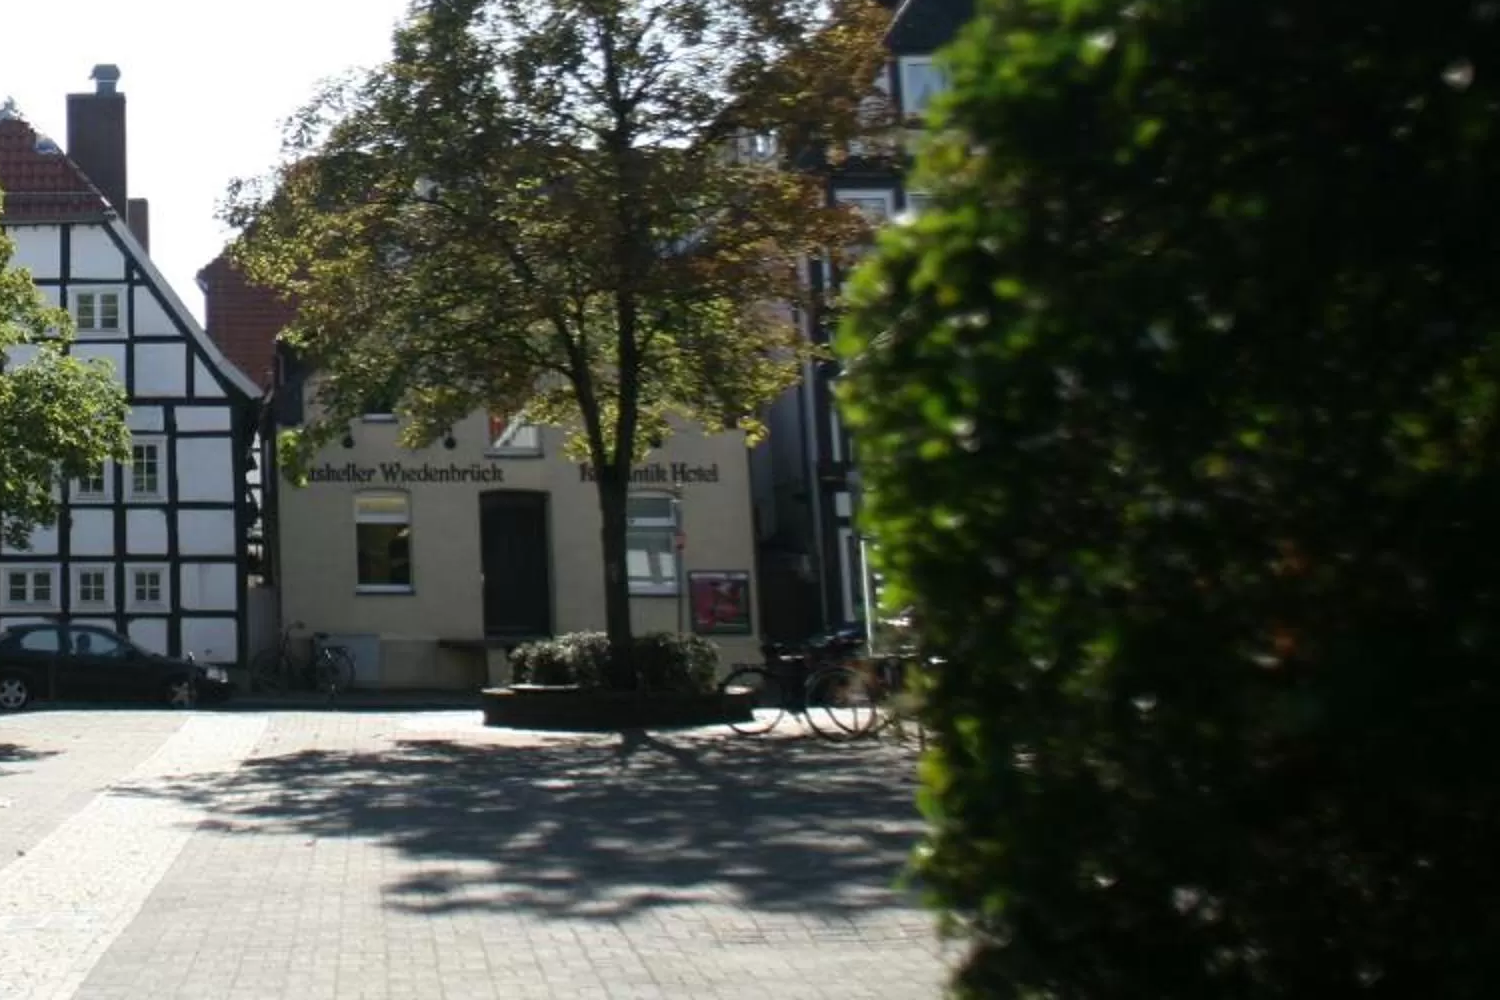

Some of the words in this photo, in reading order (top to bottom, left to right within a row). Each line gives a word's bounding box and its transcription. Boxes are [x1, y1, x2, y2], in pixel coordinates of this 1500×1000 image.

[306, 462, 375, 482] tskeller
[379, 462, 504, 483] Wiedenbrück
[670, 461, 719, 483] Hotel
